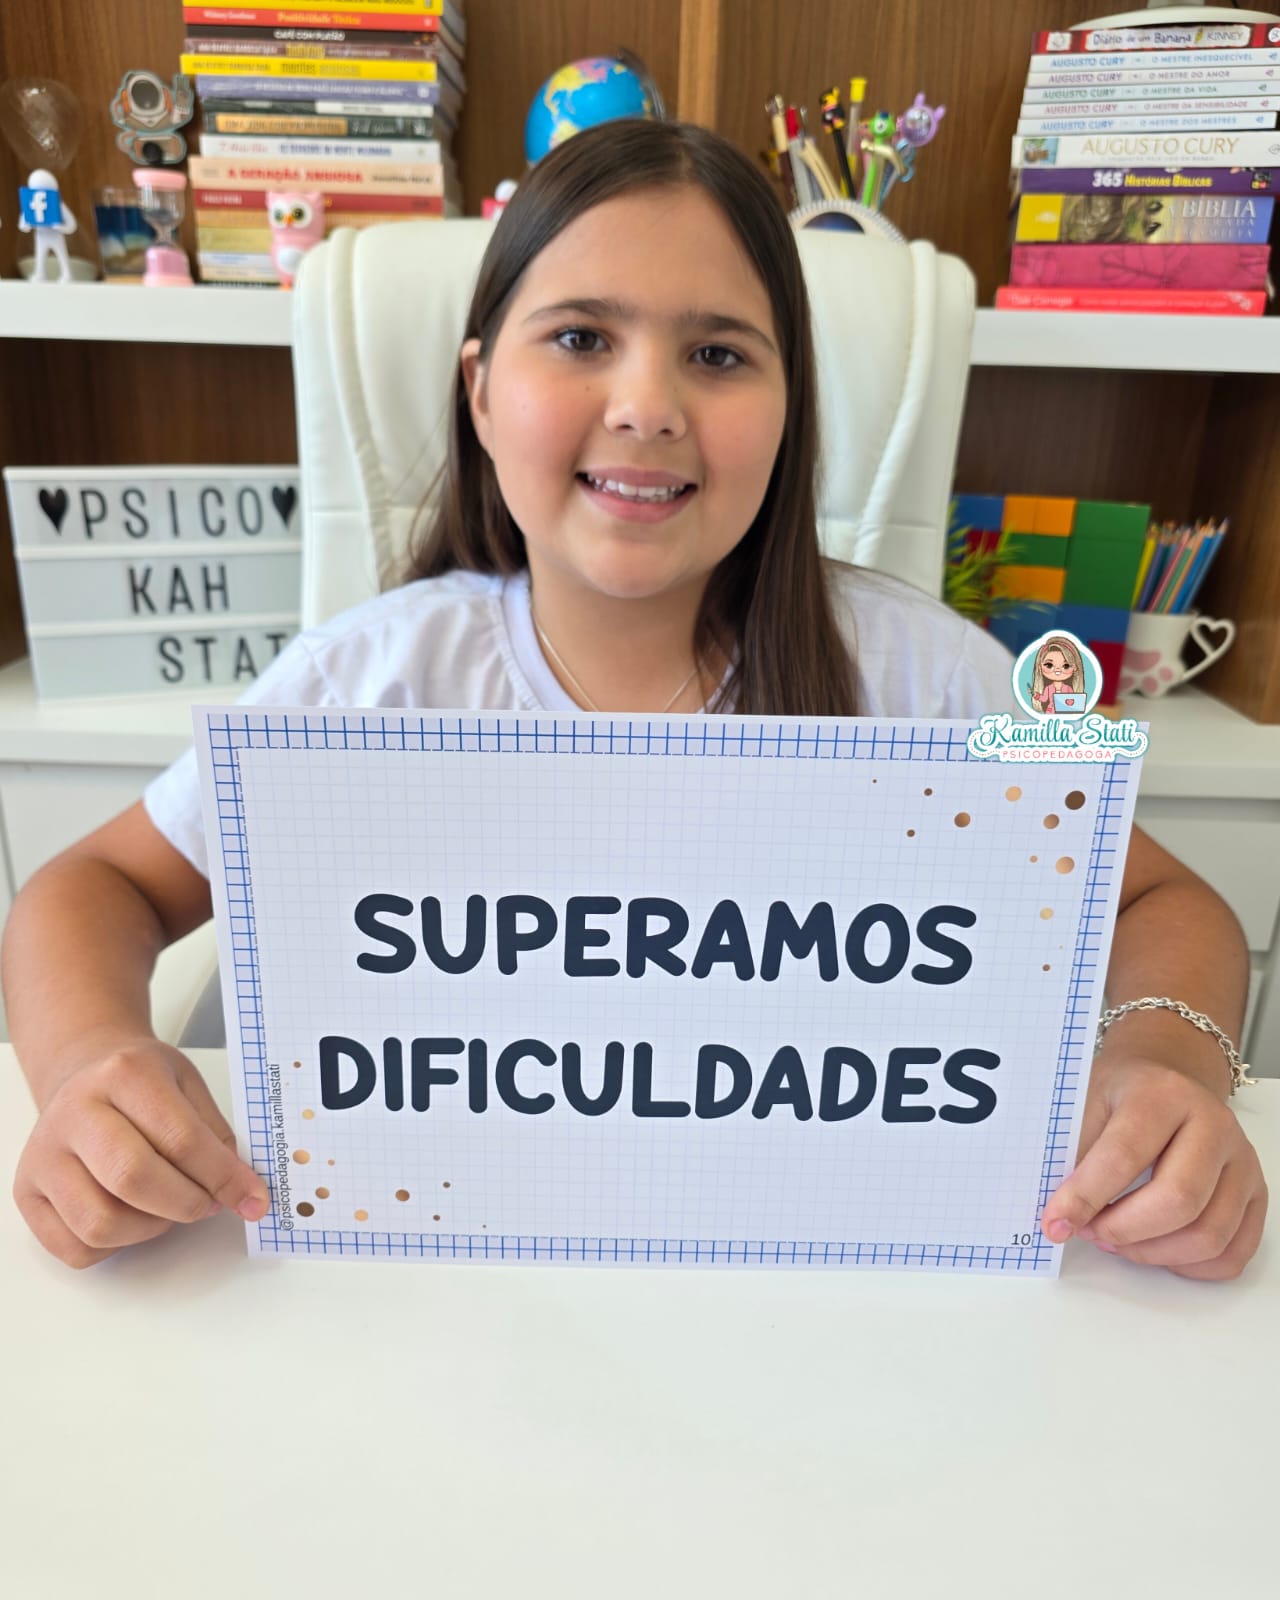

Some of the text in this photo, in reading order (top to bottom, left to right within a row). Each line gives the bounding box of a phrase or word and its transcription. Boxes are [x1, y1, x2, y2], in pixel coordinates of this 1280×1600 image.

[1154, 31, 1192, 44] Banana
[1207, 31, 1244, 41] KINNEY
[1050, 56, 1125, 67] AUGUSTO CURY
[1161, 55, 1191, 63] MESTRE
[1049, 73, 1122, 83] AUGUSTO CURY
[1042, 88, 1116, 99] AUGUSTO CURY
[1044, 103, 1118, 114] AUGUSTO CURY
[1041, 120, 1114, 131] AUGUSTO CURY
[1081, 137, 1239, 156] AUGUSTO CURY
[1092, 171, 1123, 187] 365
[80, 486, 263, 539] PSICO
[128, 564, 230, 615] KAH
[354, 893, 977, 985] SUPERAMOS
[319, 1036, 1001, 1124] DIFICULDADES
[269, 1064, 294, 1232] @psicopedagogia.kamillastati
[1010, 1233, 1032, 1246] 10
